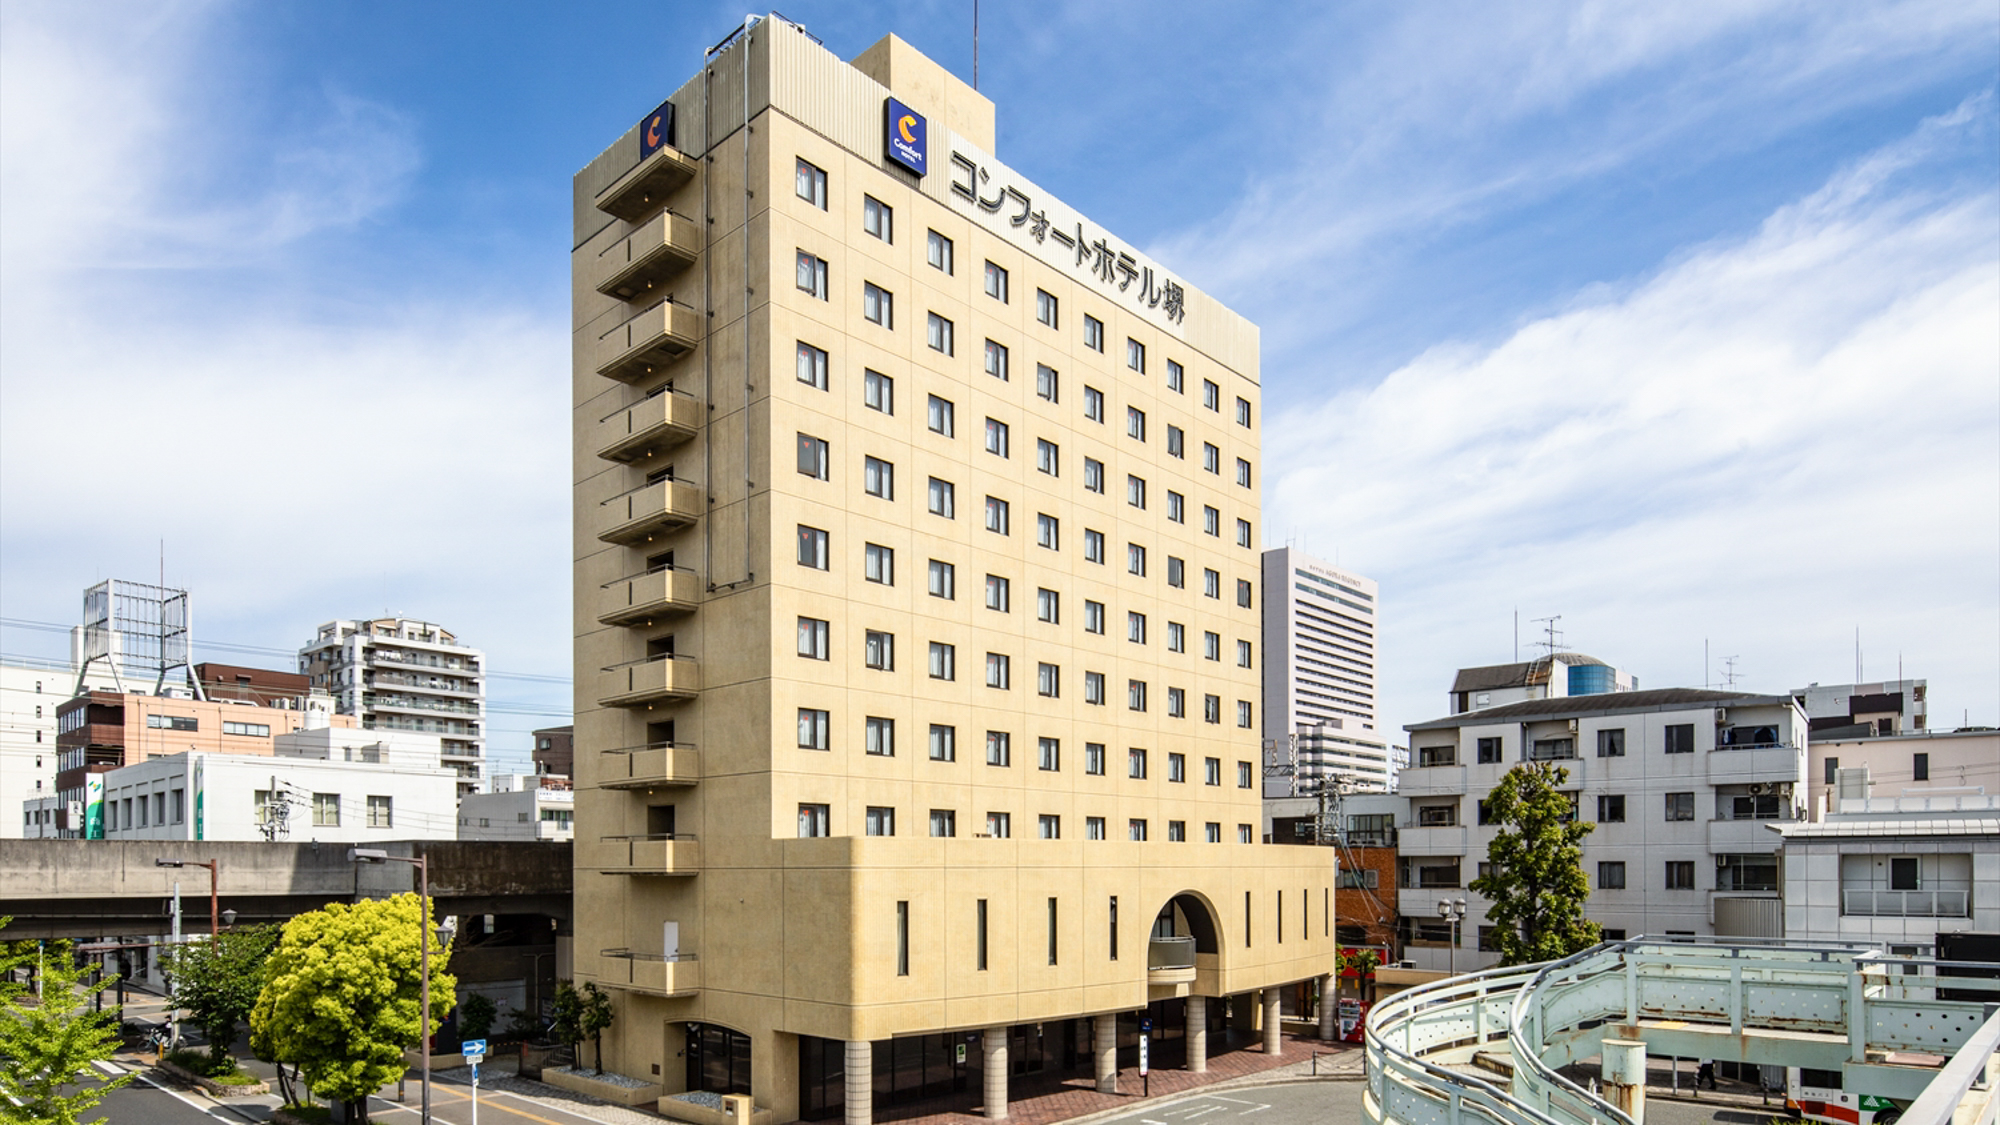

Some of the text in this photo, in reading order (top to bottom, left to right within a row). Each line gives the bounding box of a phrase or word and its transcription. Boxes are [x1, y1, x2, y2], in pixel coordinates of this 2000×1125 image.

[893, 138, 922, 161] Comfort
[950, 150, 1185, 325] コンフォートホテル堺
